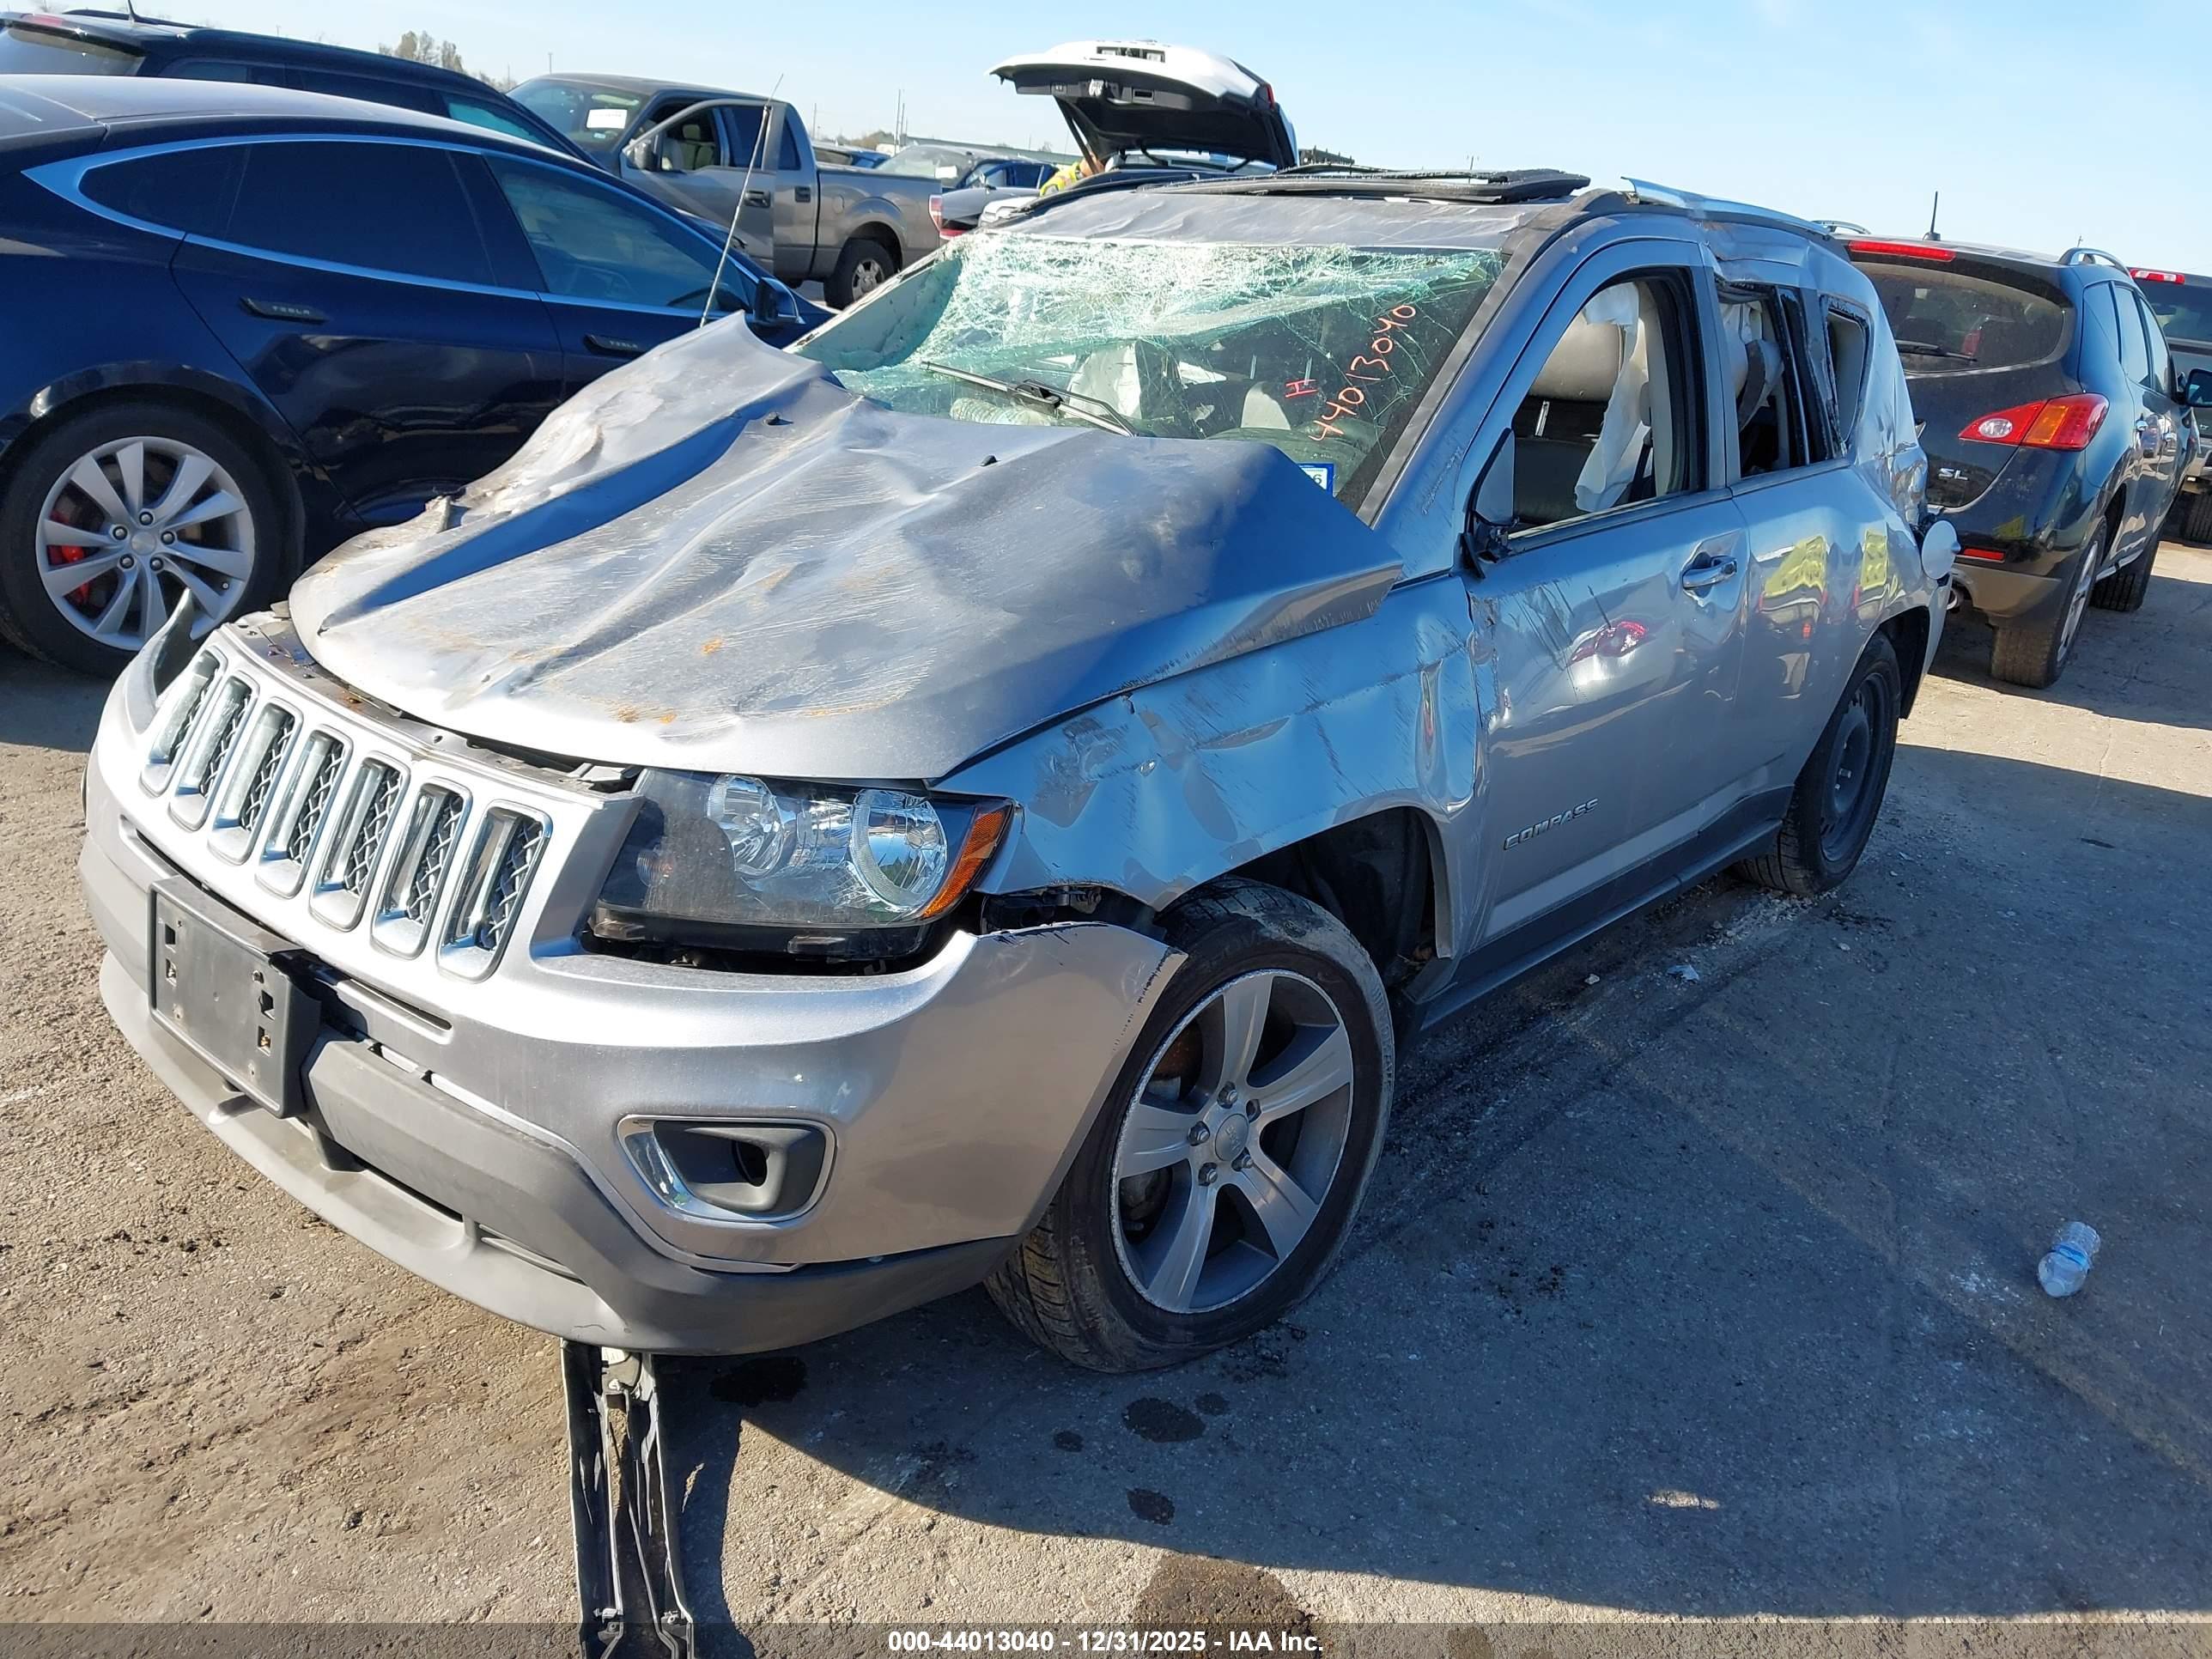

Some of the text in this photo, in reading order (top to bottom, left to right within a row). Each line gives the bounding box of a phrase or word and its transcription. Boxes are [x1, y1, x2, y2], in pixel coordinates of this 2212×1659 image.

[1308, 304, 1417, 442] 44013040
[1938, 467, 1969, 481] SL
[1504, 797, 1599, 850] COMPASS
